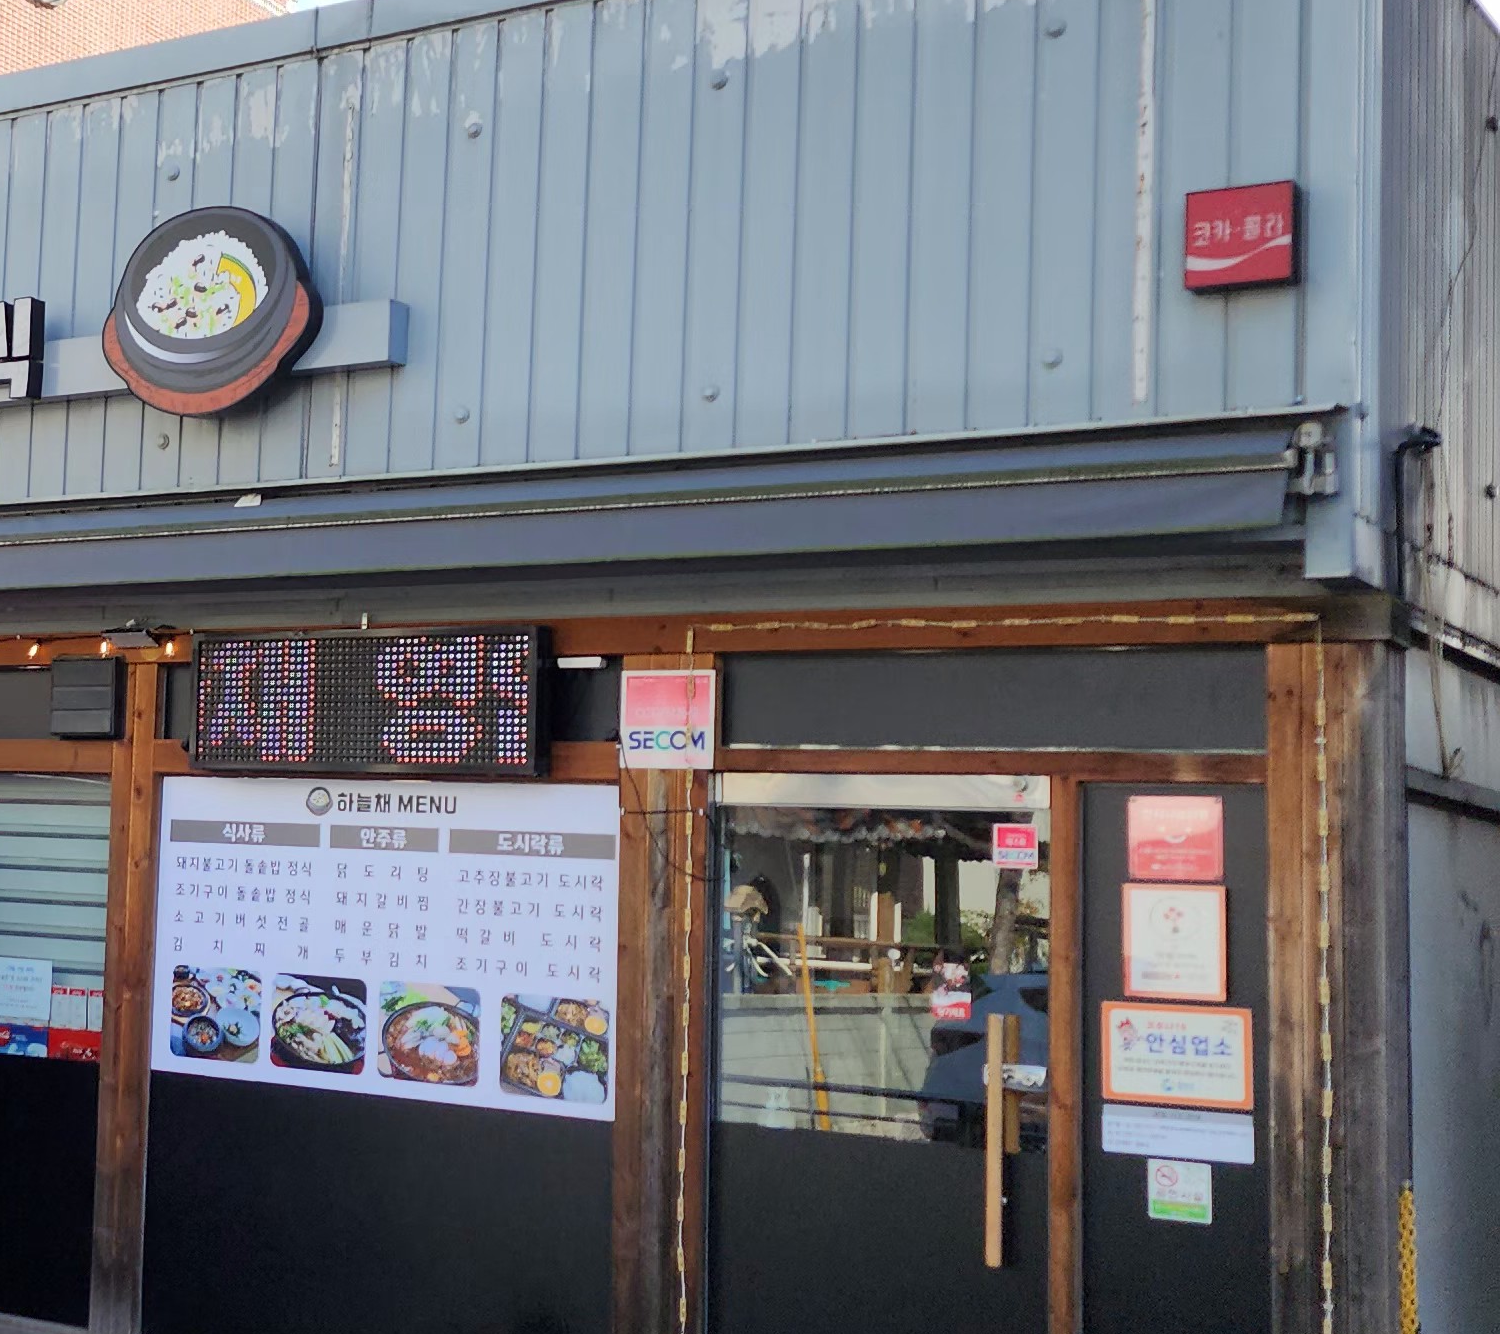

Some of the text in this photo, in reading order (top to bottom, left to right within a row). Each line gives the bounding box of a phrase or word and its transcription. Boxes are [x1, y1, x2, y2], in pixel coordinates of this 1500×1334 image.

[628, 730, 705, 751] SECOM
[337, 792, 457, 815] 하늘채 MENU
[222, 823, 266, 844] 식사류
[360, 827, 408, 849] 안주류
[496, 833, 565, 856] 도시락류
[287, 860, 313, 878] 정식
[558, 873, 604, 892] 도시락
[175, 882, 229, 899] 조기구이
[285, 888, 312, 906] 정식
[1145, 1032, 1233, 1057] 안심업소
